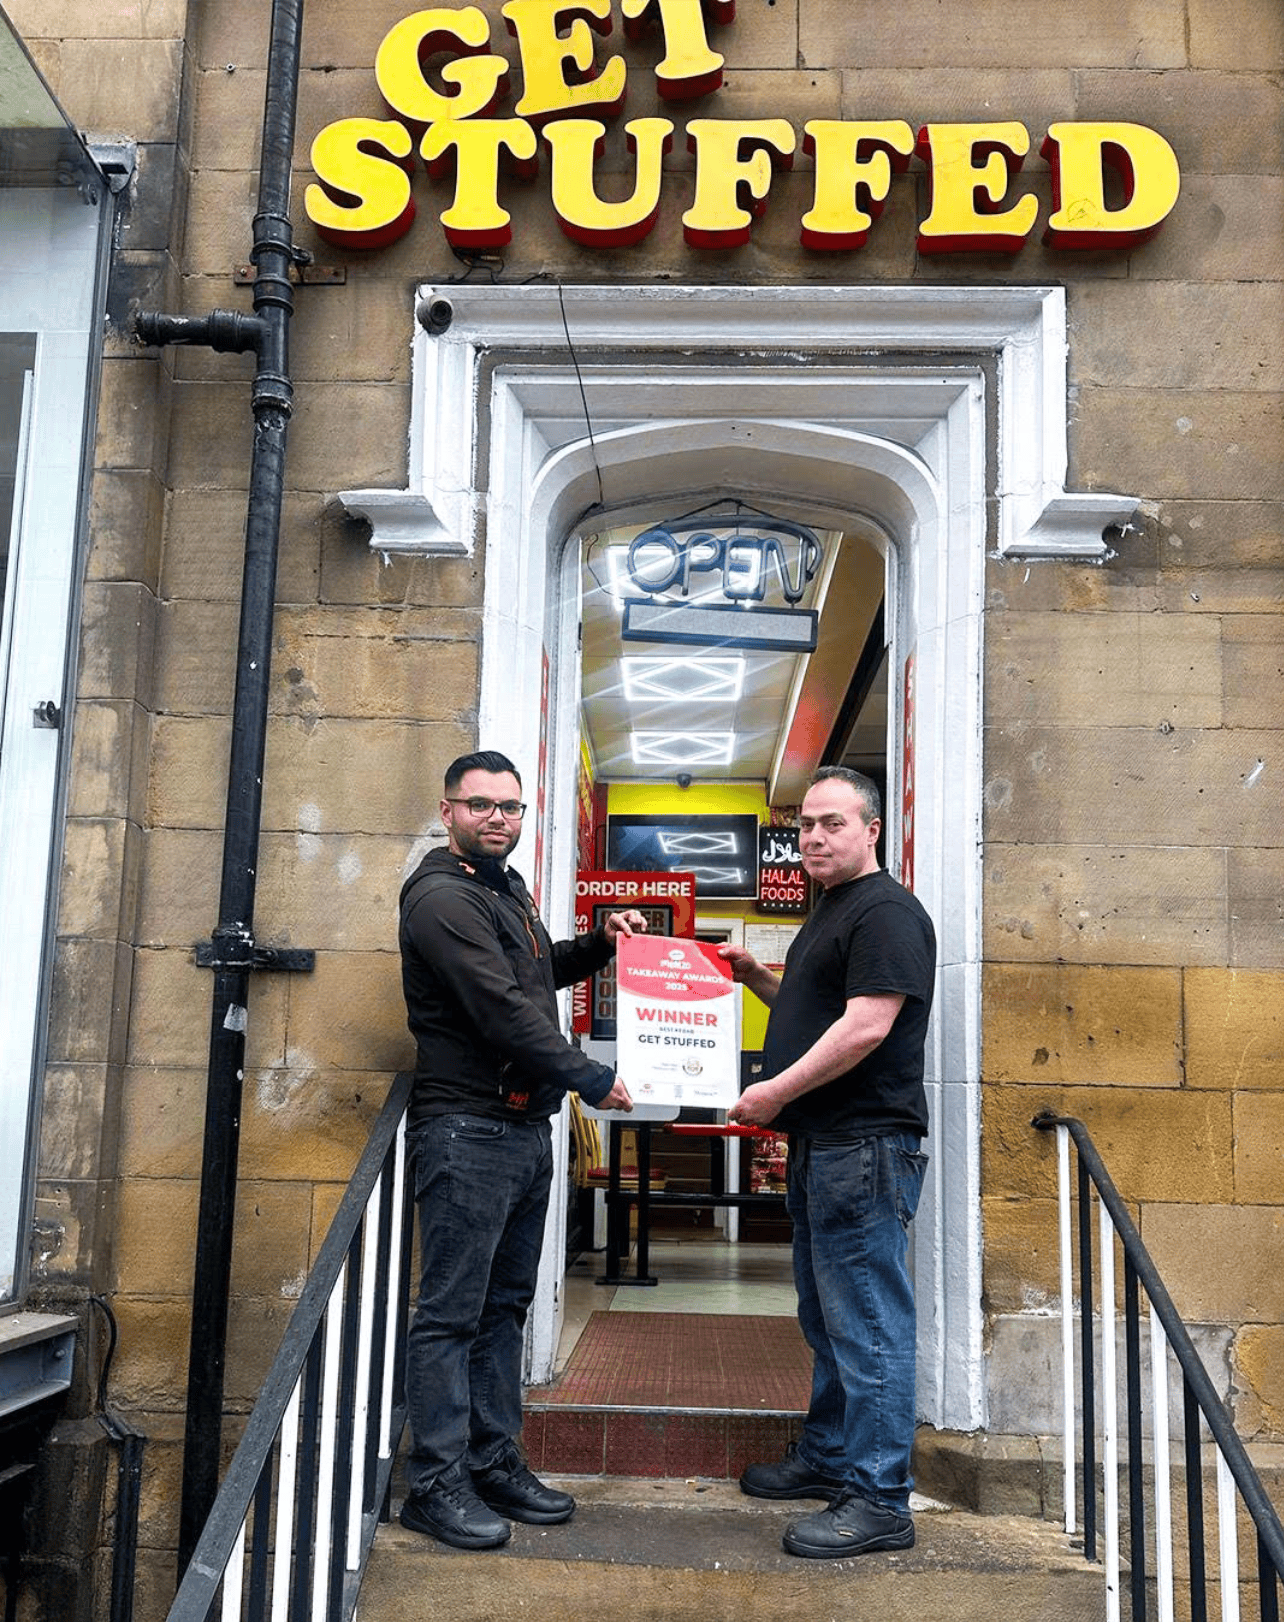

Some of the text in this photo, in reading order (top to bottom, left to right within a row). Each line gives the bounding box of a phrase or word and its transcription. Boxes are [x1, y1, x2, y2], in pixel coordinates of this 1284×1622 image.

[374, 0, 732, 122] GET
[304, 116, 1181, 245] STUFFED
[627, 530, 812, 604] OPEN
[761, 868, 804, 885] HALAL
[576, 881, 691, 897] ORDER HERE
[760, 887, 804, 901] FOODS
[627, 967, 680, 980] TAKEAWAY
[635, 1007, 718, 1027] WINNER
[638, 1034, 716, 1049] GET STUFFED
